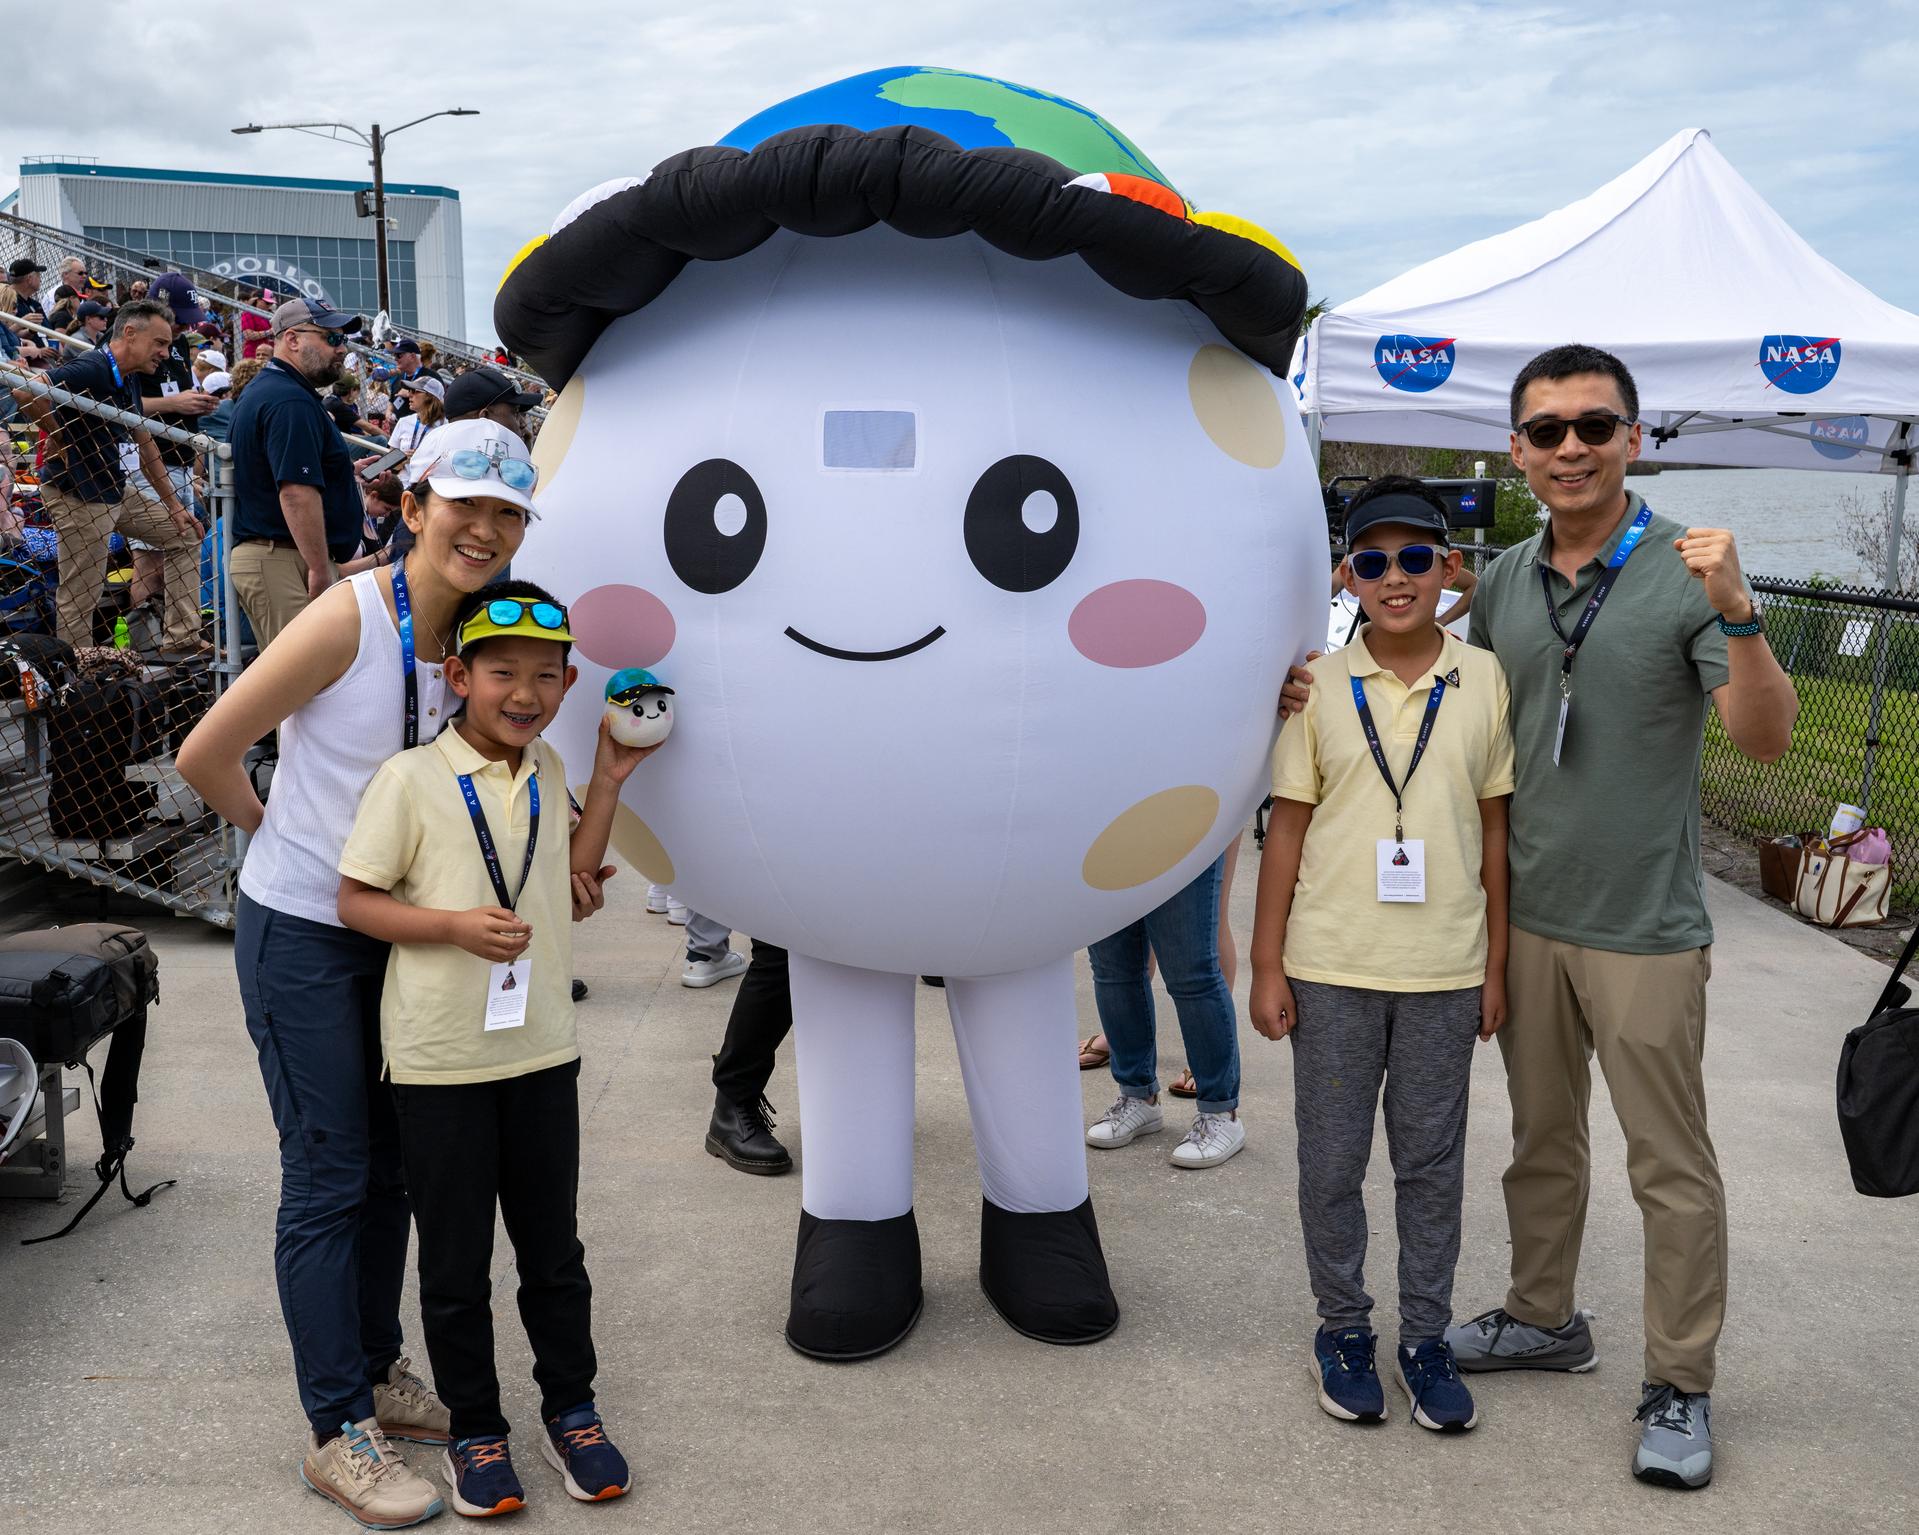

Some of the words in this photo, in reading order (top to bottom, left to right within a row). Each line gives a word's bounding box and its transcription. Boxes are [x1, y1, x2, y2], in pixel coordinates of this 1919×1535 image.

[1381, 349, 1450, 364] NASA
[1766, 346, 1836, 364] NASA
[396, 583, 411, 644] ARTEMIS
